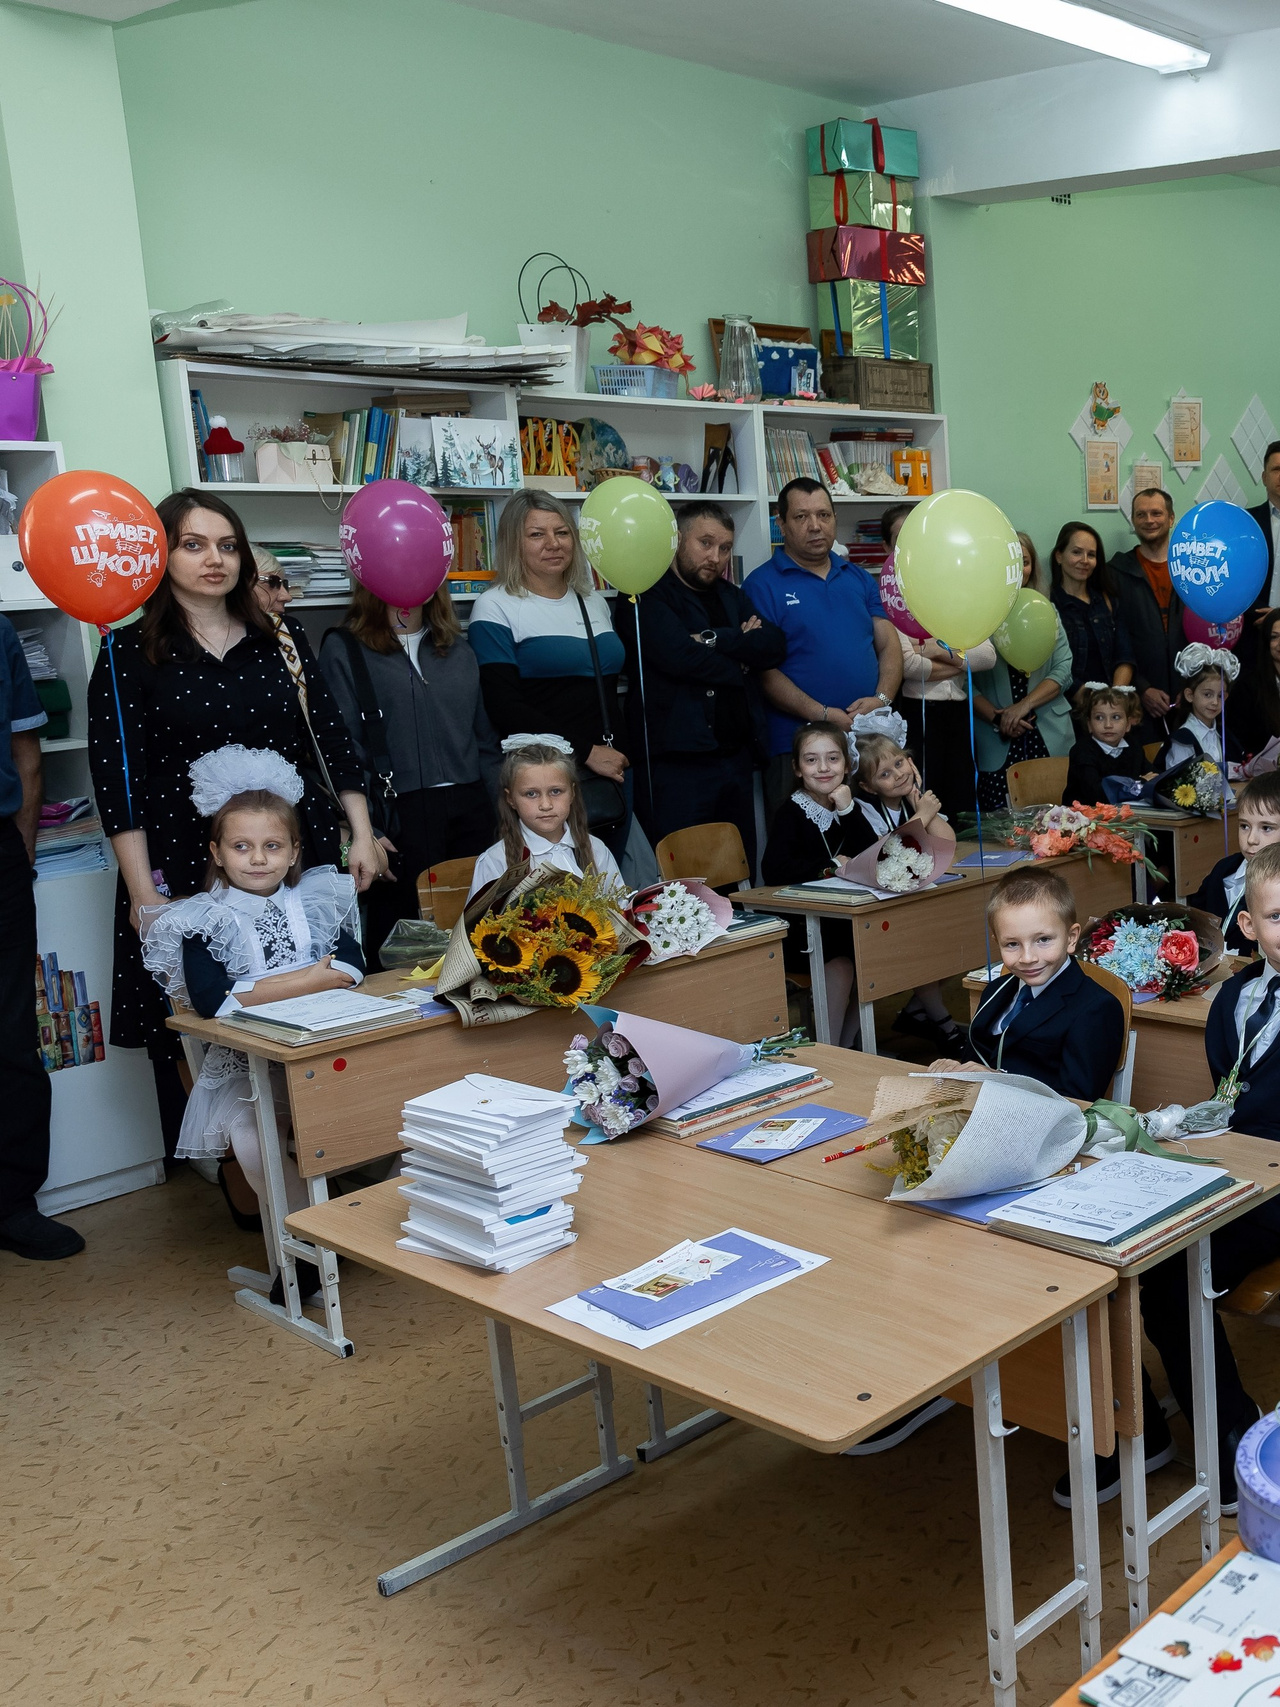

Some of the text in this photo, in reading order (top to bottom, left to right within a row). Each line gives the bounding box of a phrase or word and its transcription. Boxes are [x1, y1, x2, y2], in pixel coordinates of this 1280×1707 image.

[74, 522, 158, 549] ПРИВЕТ,
[581, 535, 604, 555] ОЛА
[70, 543, 160, 577] ШКОЛА
[1172, 540, 1228, 561] ПРИВЕТ,
[1170, 560, 1230, 586] ШКОЛА
[880, 589, 906, 612] ШКО
